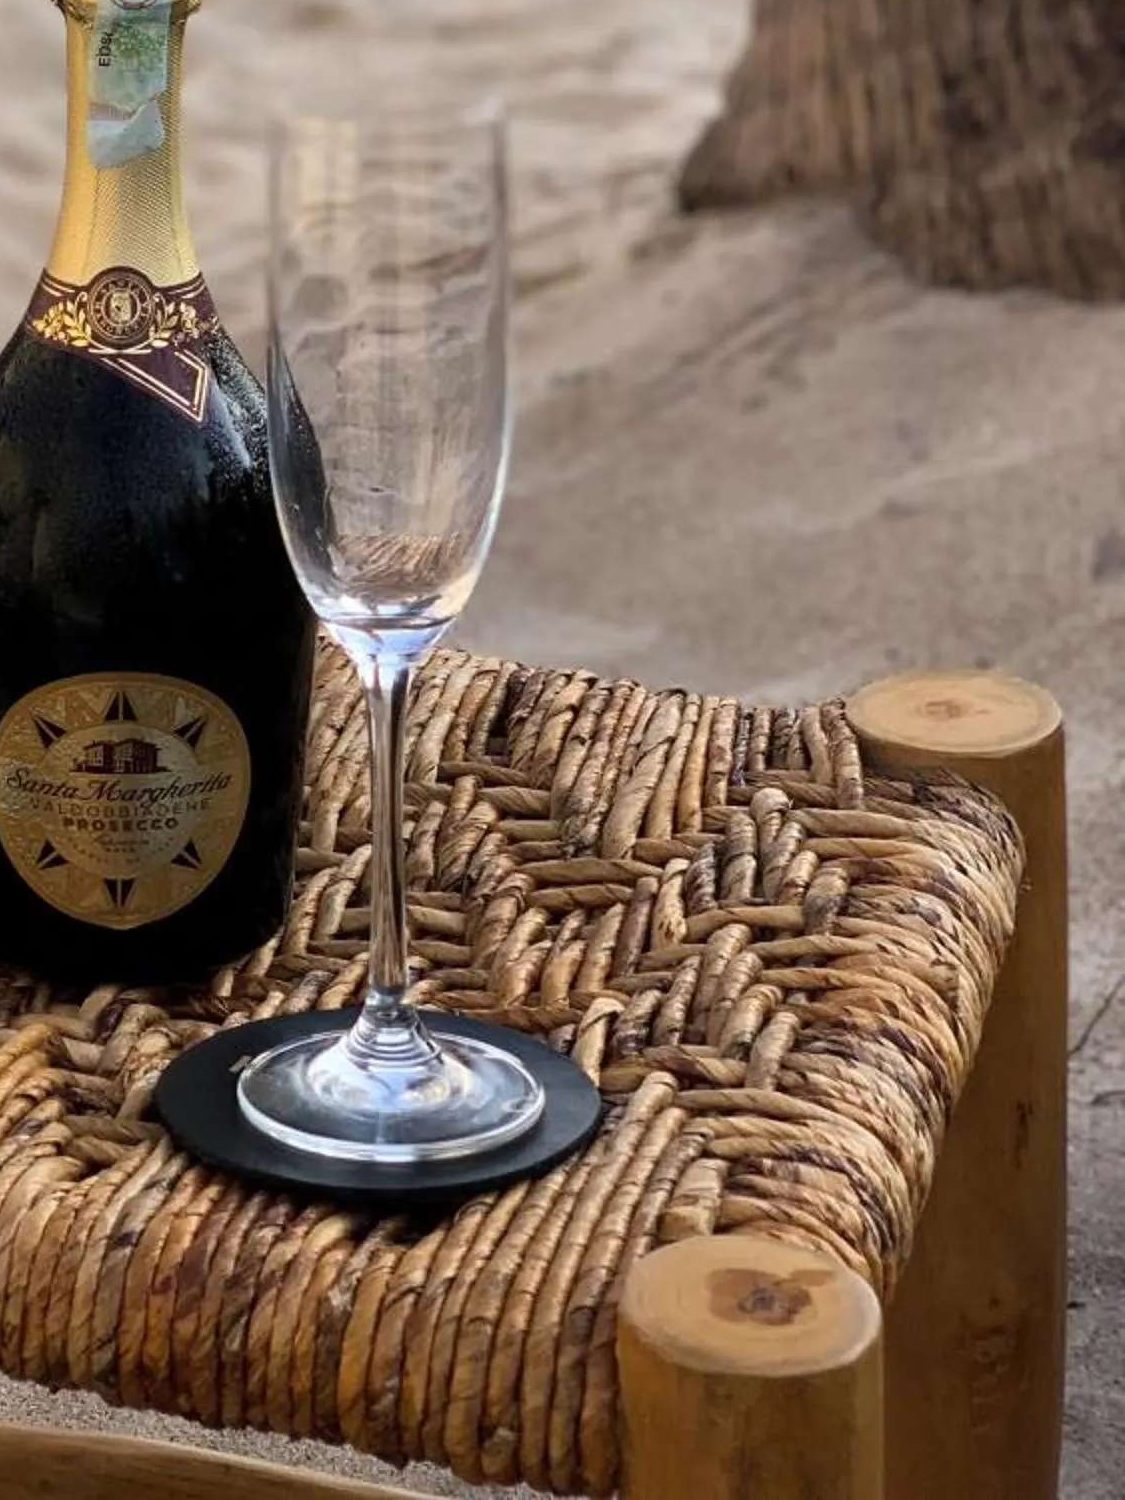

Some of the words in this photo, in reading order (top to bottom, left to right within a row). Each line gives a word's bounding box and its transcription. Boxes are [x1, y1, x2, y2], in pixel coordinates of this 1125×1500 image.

[7, 767, 80, 799] Santa
[78, 771, 232, 809] Margherita
[62, 817, 180, 832] PROSECCO
